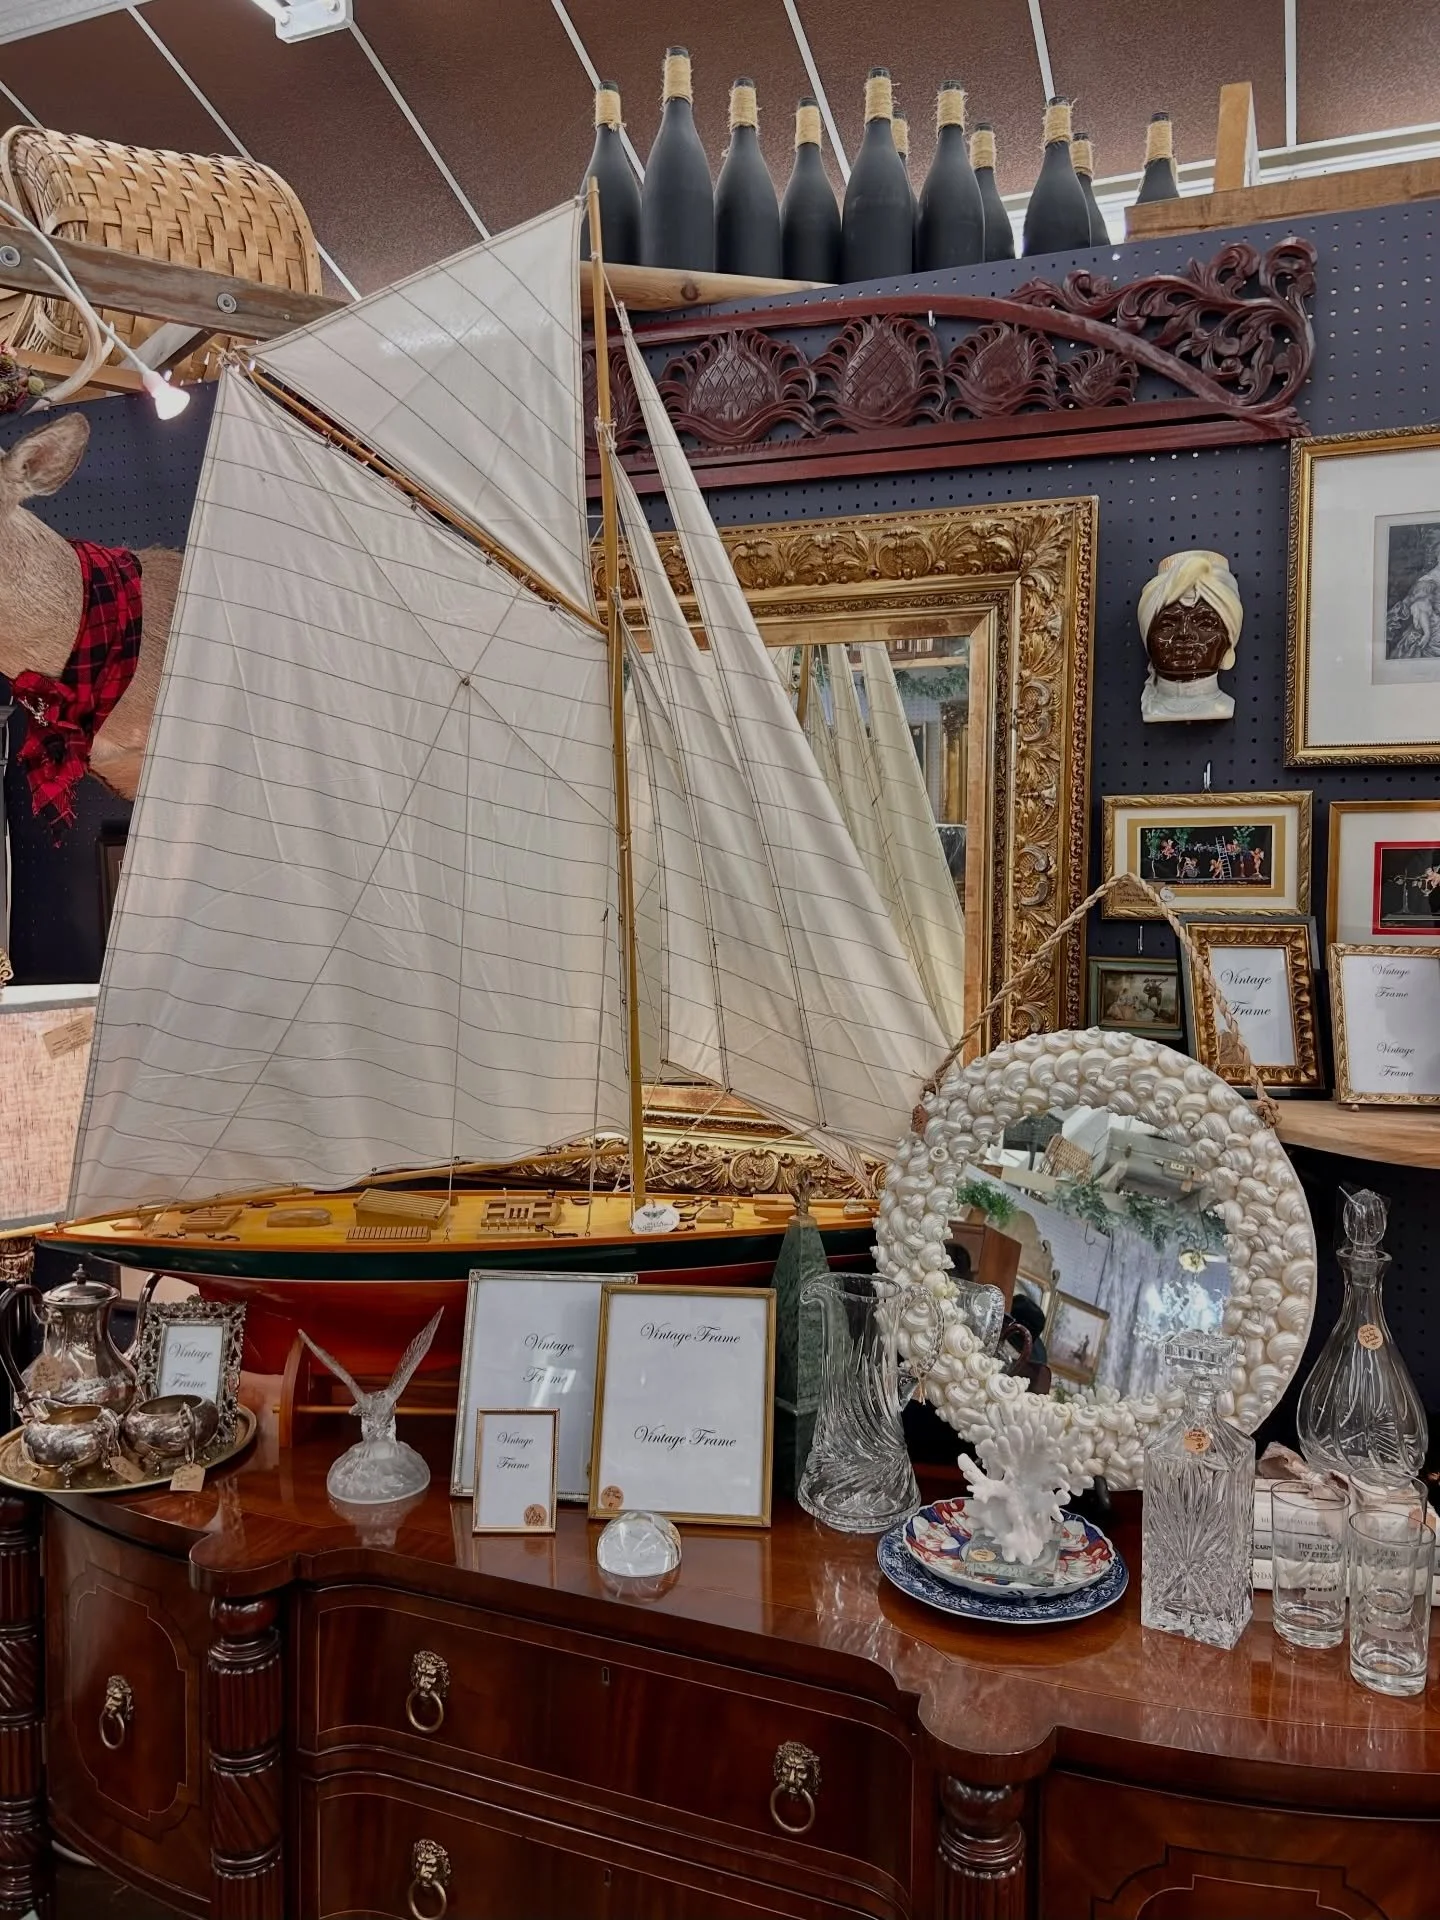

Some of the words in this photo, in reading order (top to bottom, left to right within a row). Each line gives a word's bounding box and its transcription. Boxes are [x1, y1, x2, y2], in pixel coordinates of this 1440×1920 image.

[1220, 967, 1272, 991] Vintage
[1371, 963, 1411, 980] Vintage
[1375, 986, 1409, 999] Frame
[1229, 1000, 1272, 1018] Frame
[1376, 1041, 1415, 1058] Vintage
[1379, 1064, 1415, 1078] Frame
[639, 1322, 692, 1348] Vintage
[693, 1325, 741, 1345] Frame
[168, 1342, 213, 1363] Vintage
[524, 1332, 575, 1357] Vintage
[166, 1372, 207, 1389] Frame
[496, 1431, 534, 1449] Vintage
[633, 1424, 687, 1450] Vintage
[688, 1428, 737, 1448] Frame
[496, 1456, 530, 1470] Frame
